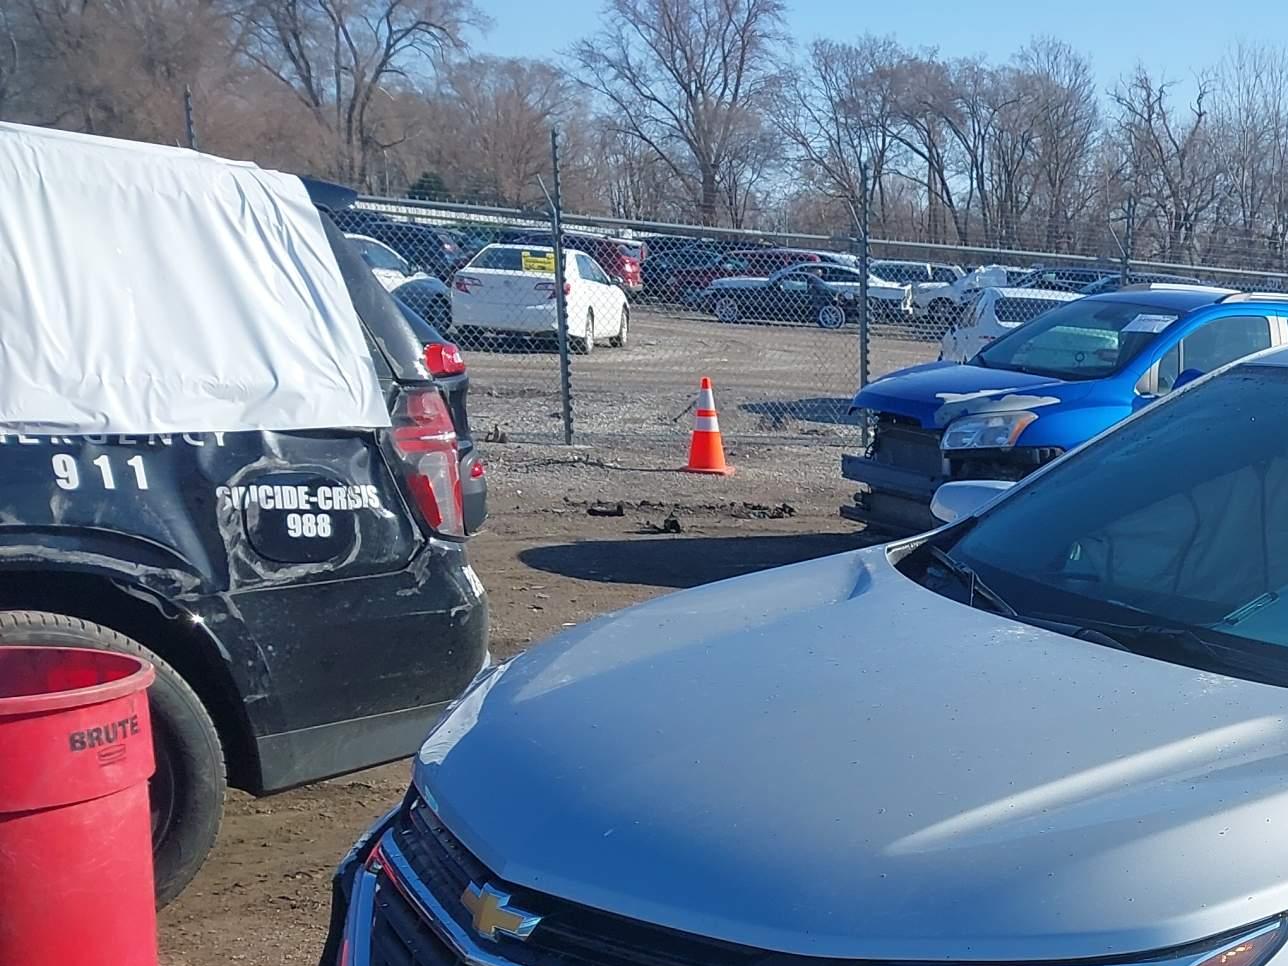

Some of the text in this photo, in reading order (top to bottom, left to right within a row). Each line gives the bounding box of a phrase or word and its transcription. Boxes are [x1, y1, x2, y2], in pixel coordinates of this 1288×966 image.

[51, 453, 149, 490] 911
[286, 513, 331, 538] 988
[69, 714, 140, 752] BRUTE
